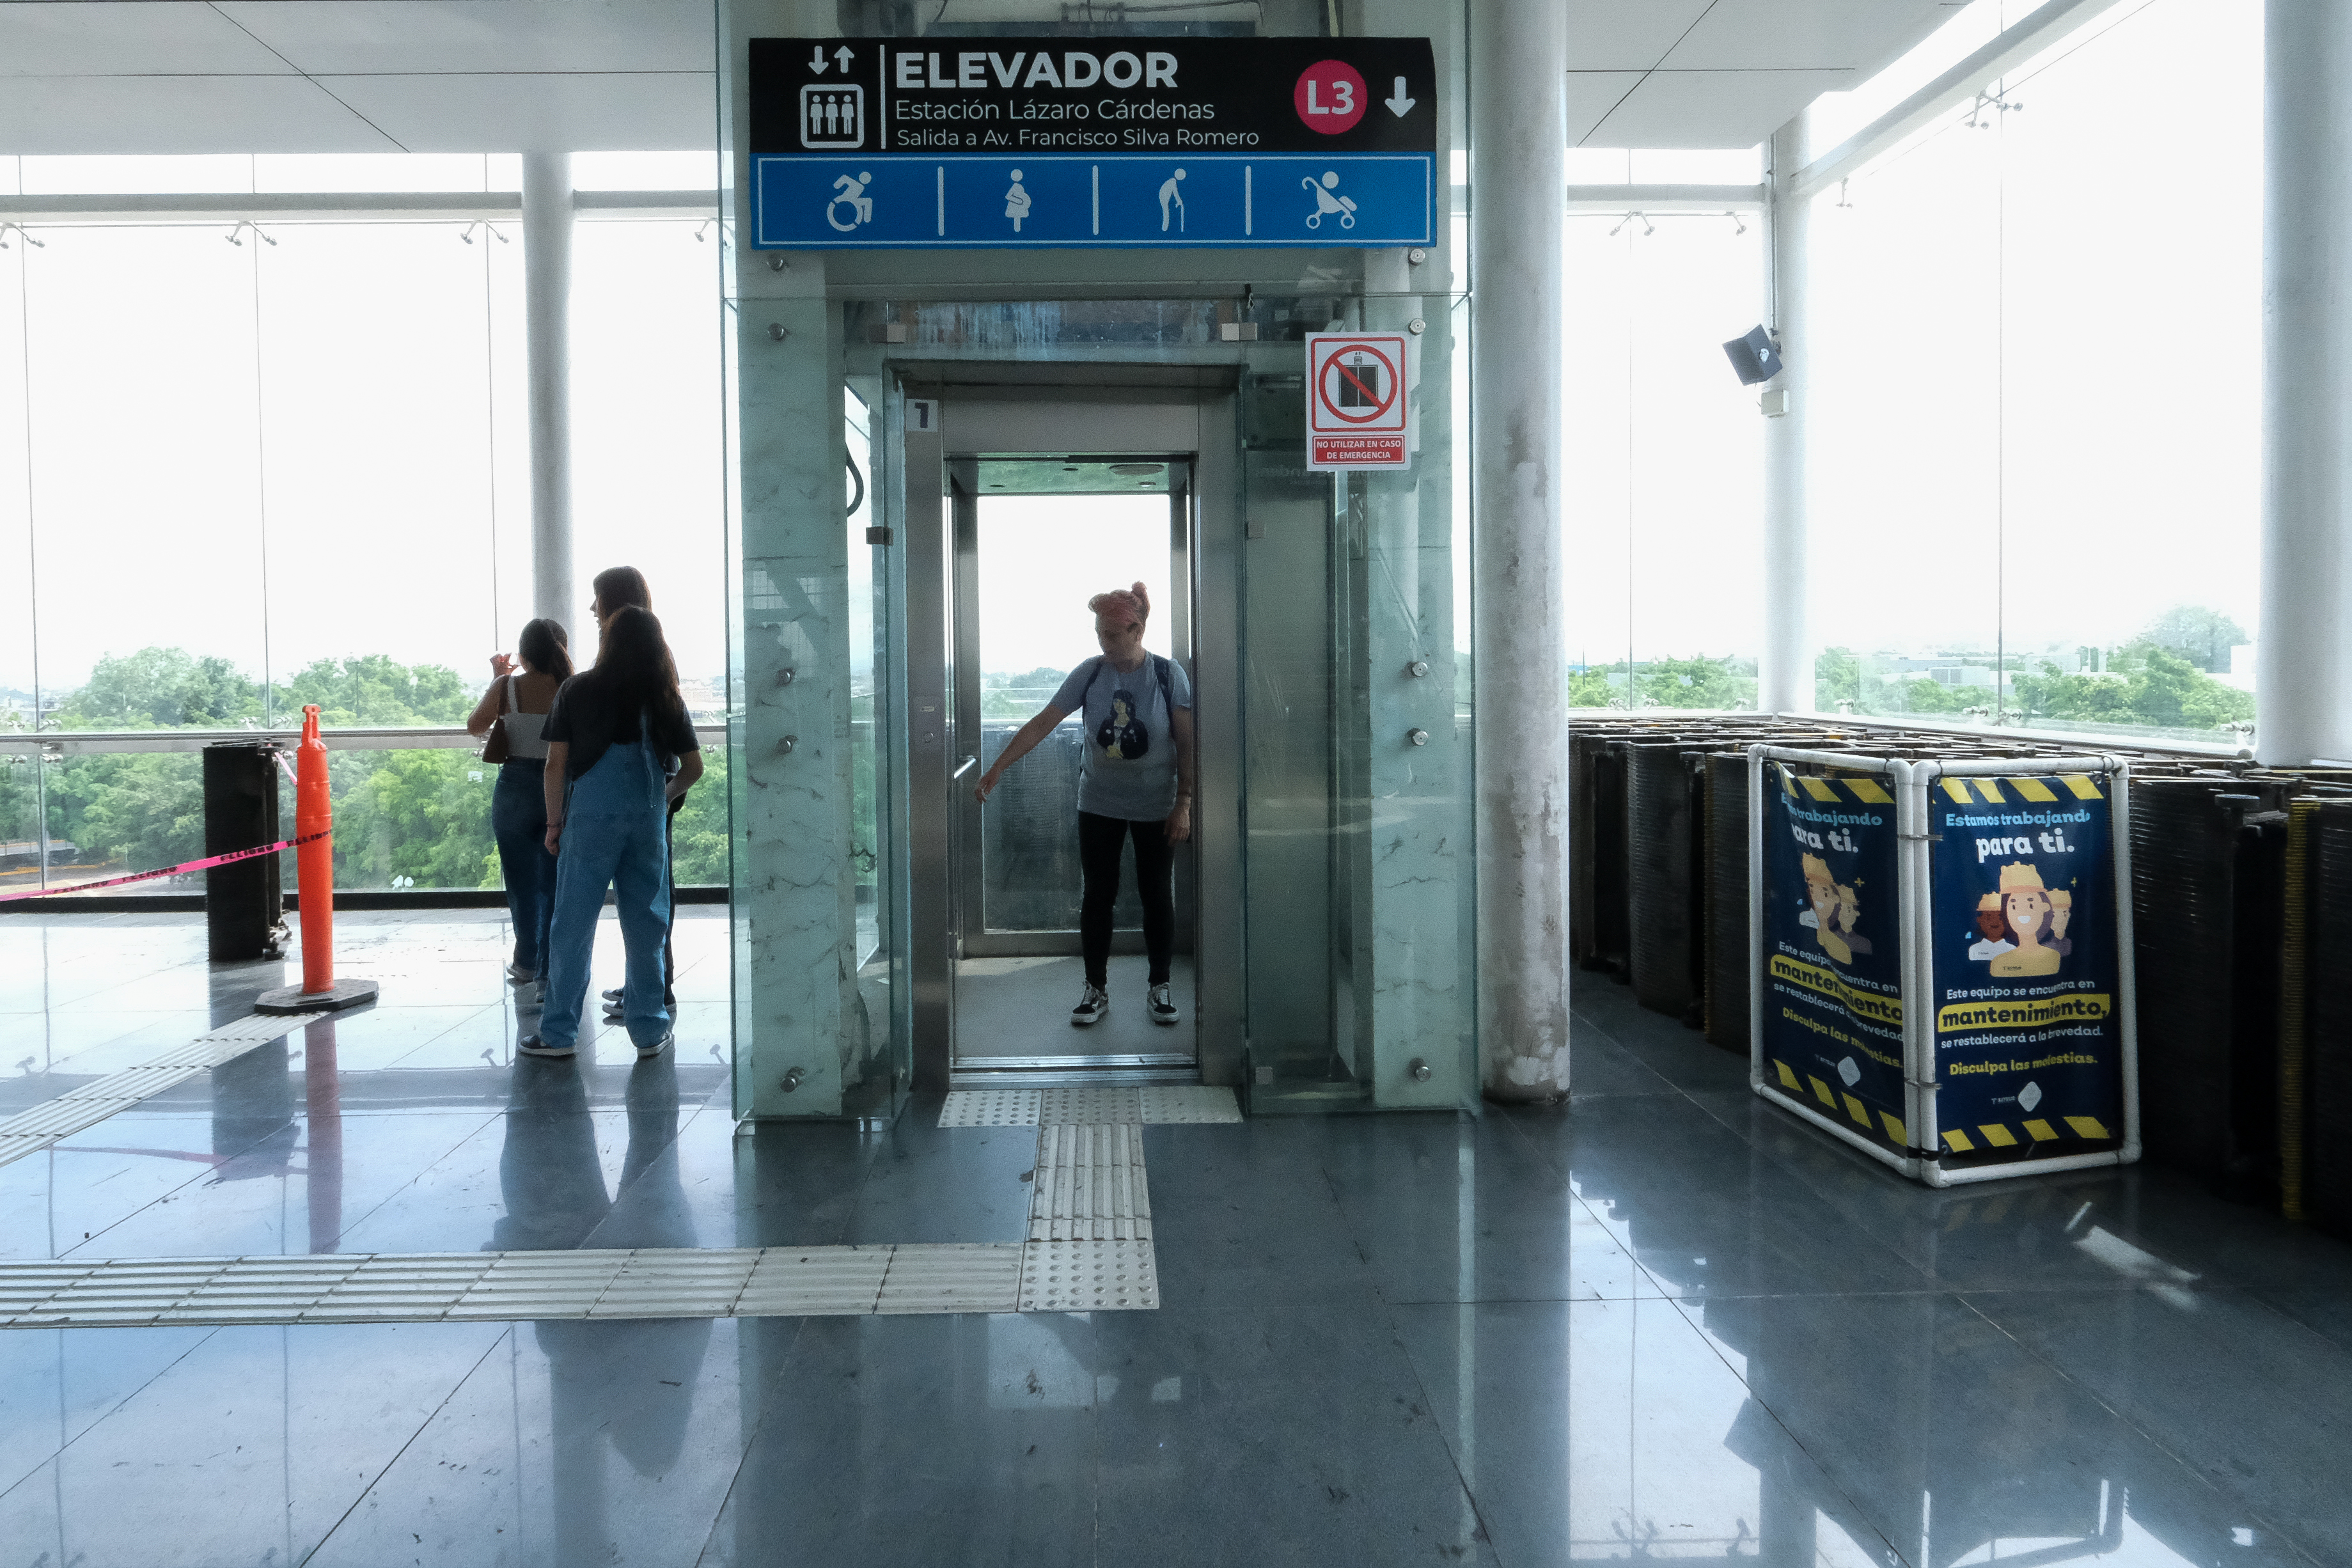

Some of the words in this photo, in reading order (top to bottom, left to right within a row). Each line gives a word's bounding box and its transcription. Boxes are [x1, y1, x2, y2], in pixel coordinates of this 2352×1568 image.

[896, 51, 1179, 88] ELEVADOR
[897, 99, 999, 120] Estación
[1010, 99, 1090, 120] Lázaro
[1098, 99, 1215, 120] Cárdenas
[1307, 80, 1354, 114] L3
[897, 129, 959, 146] Salida
[966, 132, 976, 146] a
[984, 129, 1012, 146] Av.
[1019, 129, 1117, 146] Francisco
[1124, 129, 1170, 146] Silva
[1177, 129, 1259, 146] Romero
[914, 402, 929, 428] 1
[1330, 440, 1365, 448] UTILIZAR
[1339, 451, 1391, 459] EMERGENCIA
[1946, 813, 2000, 827] Estamos
[1791, 822, 1824, 850] ara
[1828, 827, 1859, 853] ti.
[1976, 835, 2034, 863] para
[2038, 827, 2075, 854] ti.
[1779, 941, 1798, 955] Este
[1882, 984, 1898, 994] en
[1773, 983, 1785, 992] se
[1786, 986, 1846, 1015] restablecerá
[1947, 989, 1968, 1000] Este
[1970, 985, 2011, 1000] equipo
[2013, 987, 2027, 996] se
[2028, 980, 2076, 996] encuentra
[2078, 980, 2096, 989] en
[1782, 1006, 1828, 1034] Disculpa
[1830, 1026, 1849, 1043] las
[1942, 998, 2108, 1027] mantenimiento,
[1941, 1040, 1952, 1049] se
[1954, 1032, 2027, 1047] restablecerá
[2028, 1034, 2037, 1042] a
[2038, 1031, 2047, 1042] la
[2048, 1025, 2103, 1040] brevedad.
[1950, 1060, 2008, 1076] Disculpa
[2011, 1059, 2030, 1071] las
[2032, 1051, 2098, 1069] molestias.
